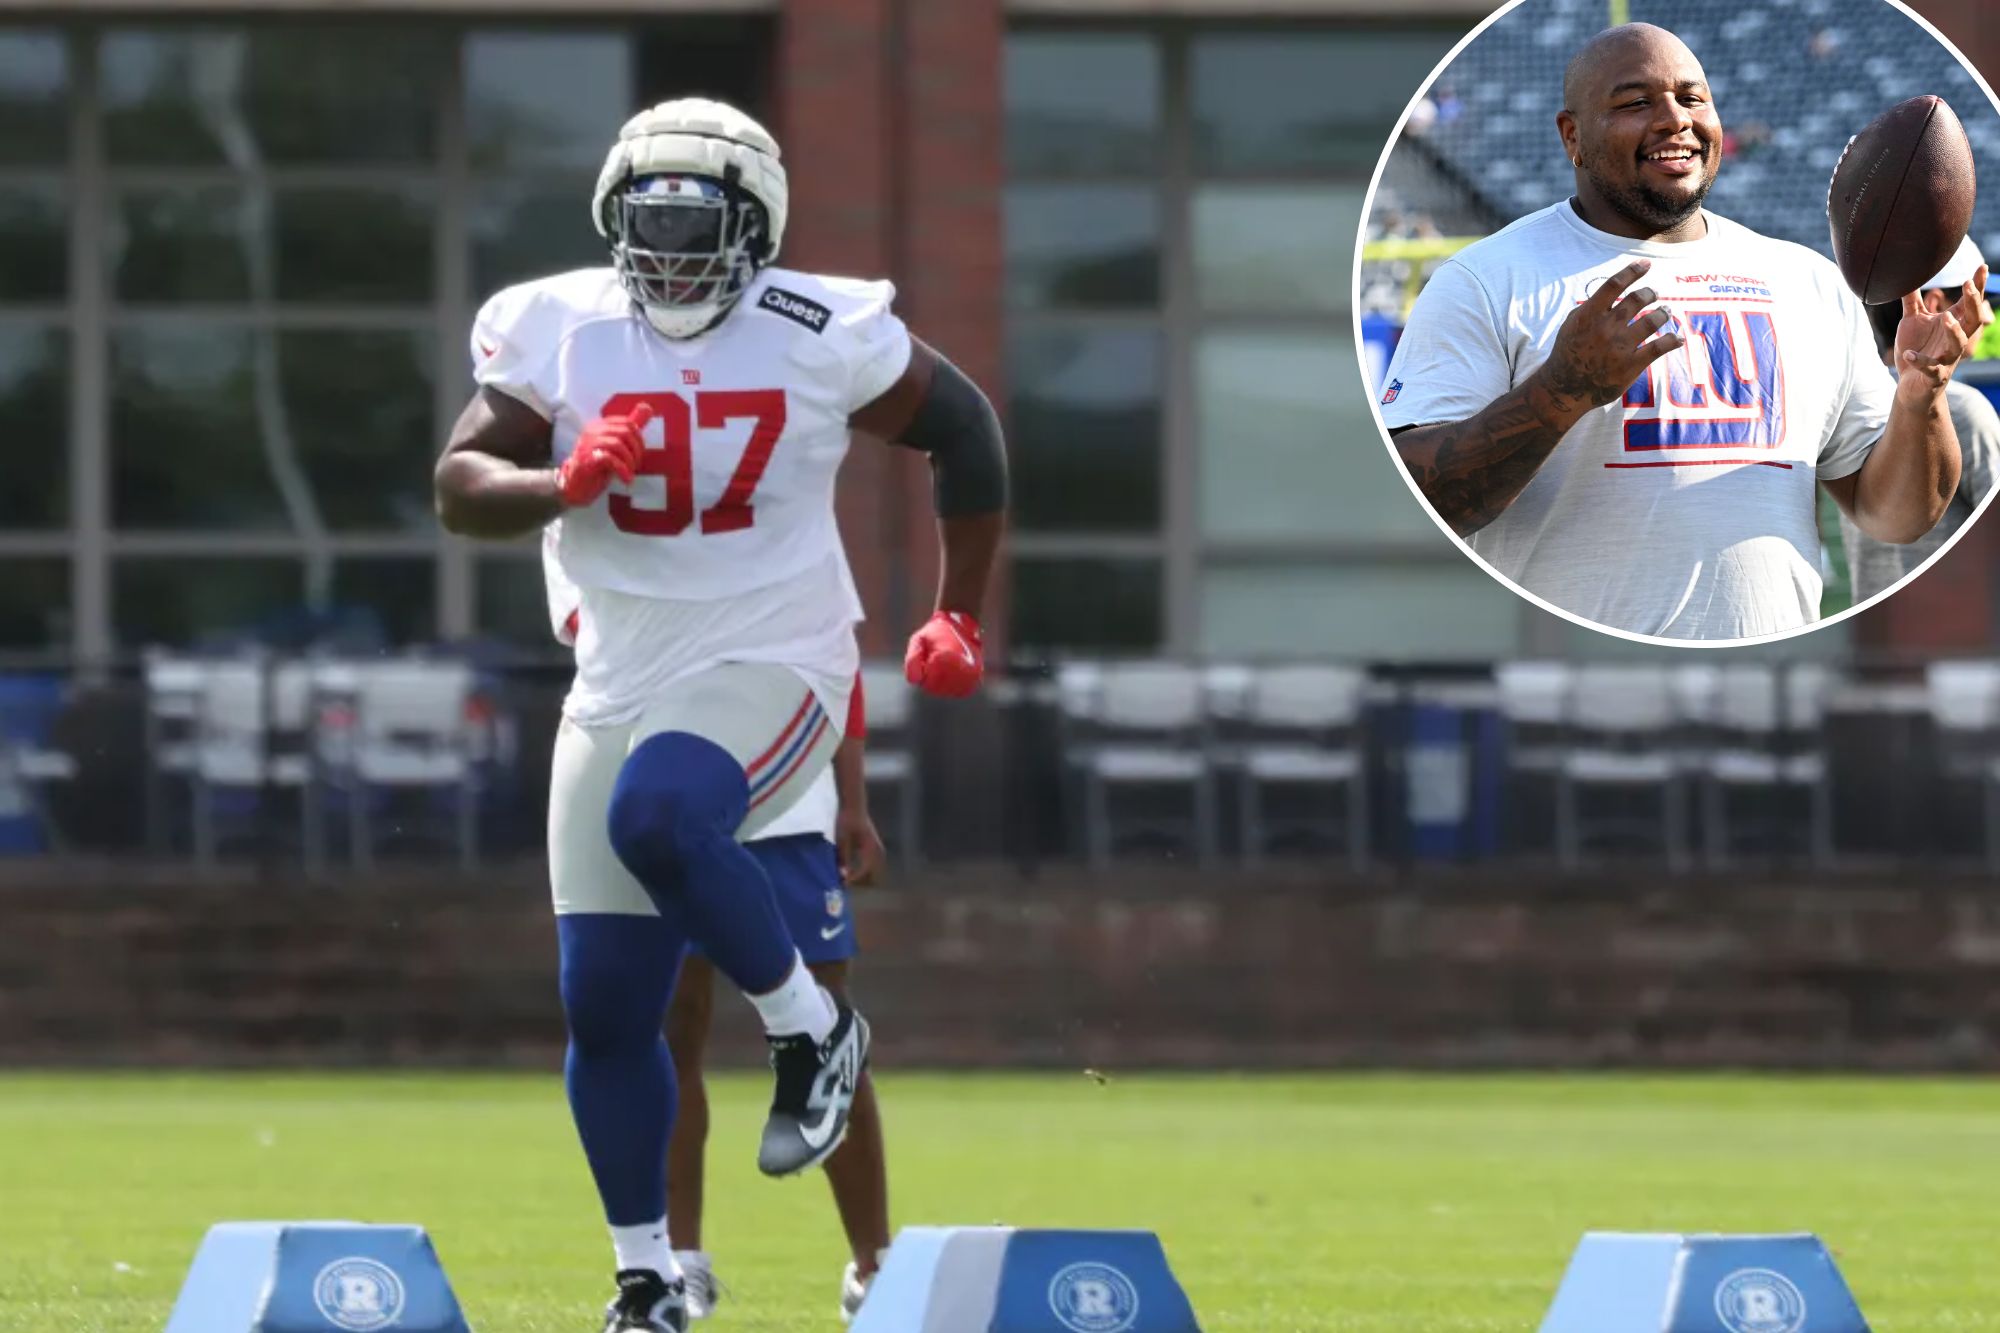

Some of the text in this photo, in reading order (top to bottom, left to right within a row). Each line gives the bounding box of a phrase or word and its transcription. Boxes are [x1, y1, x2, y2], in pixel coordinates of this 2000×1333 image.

[1849, 181, 1869, 223] FOOTBALL
[1675, 274, 1768, 286] NEW YORK
[1709, 285, 1771, 296] GIANTS
[764, 292, 827, 327] Quest
[600, 389, 787, 537] 97
[341, 1276, 380, 1311] R
[1074, 1281, 1114, 1315] R
[1741, 1289, 1780, 1322] R
